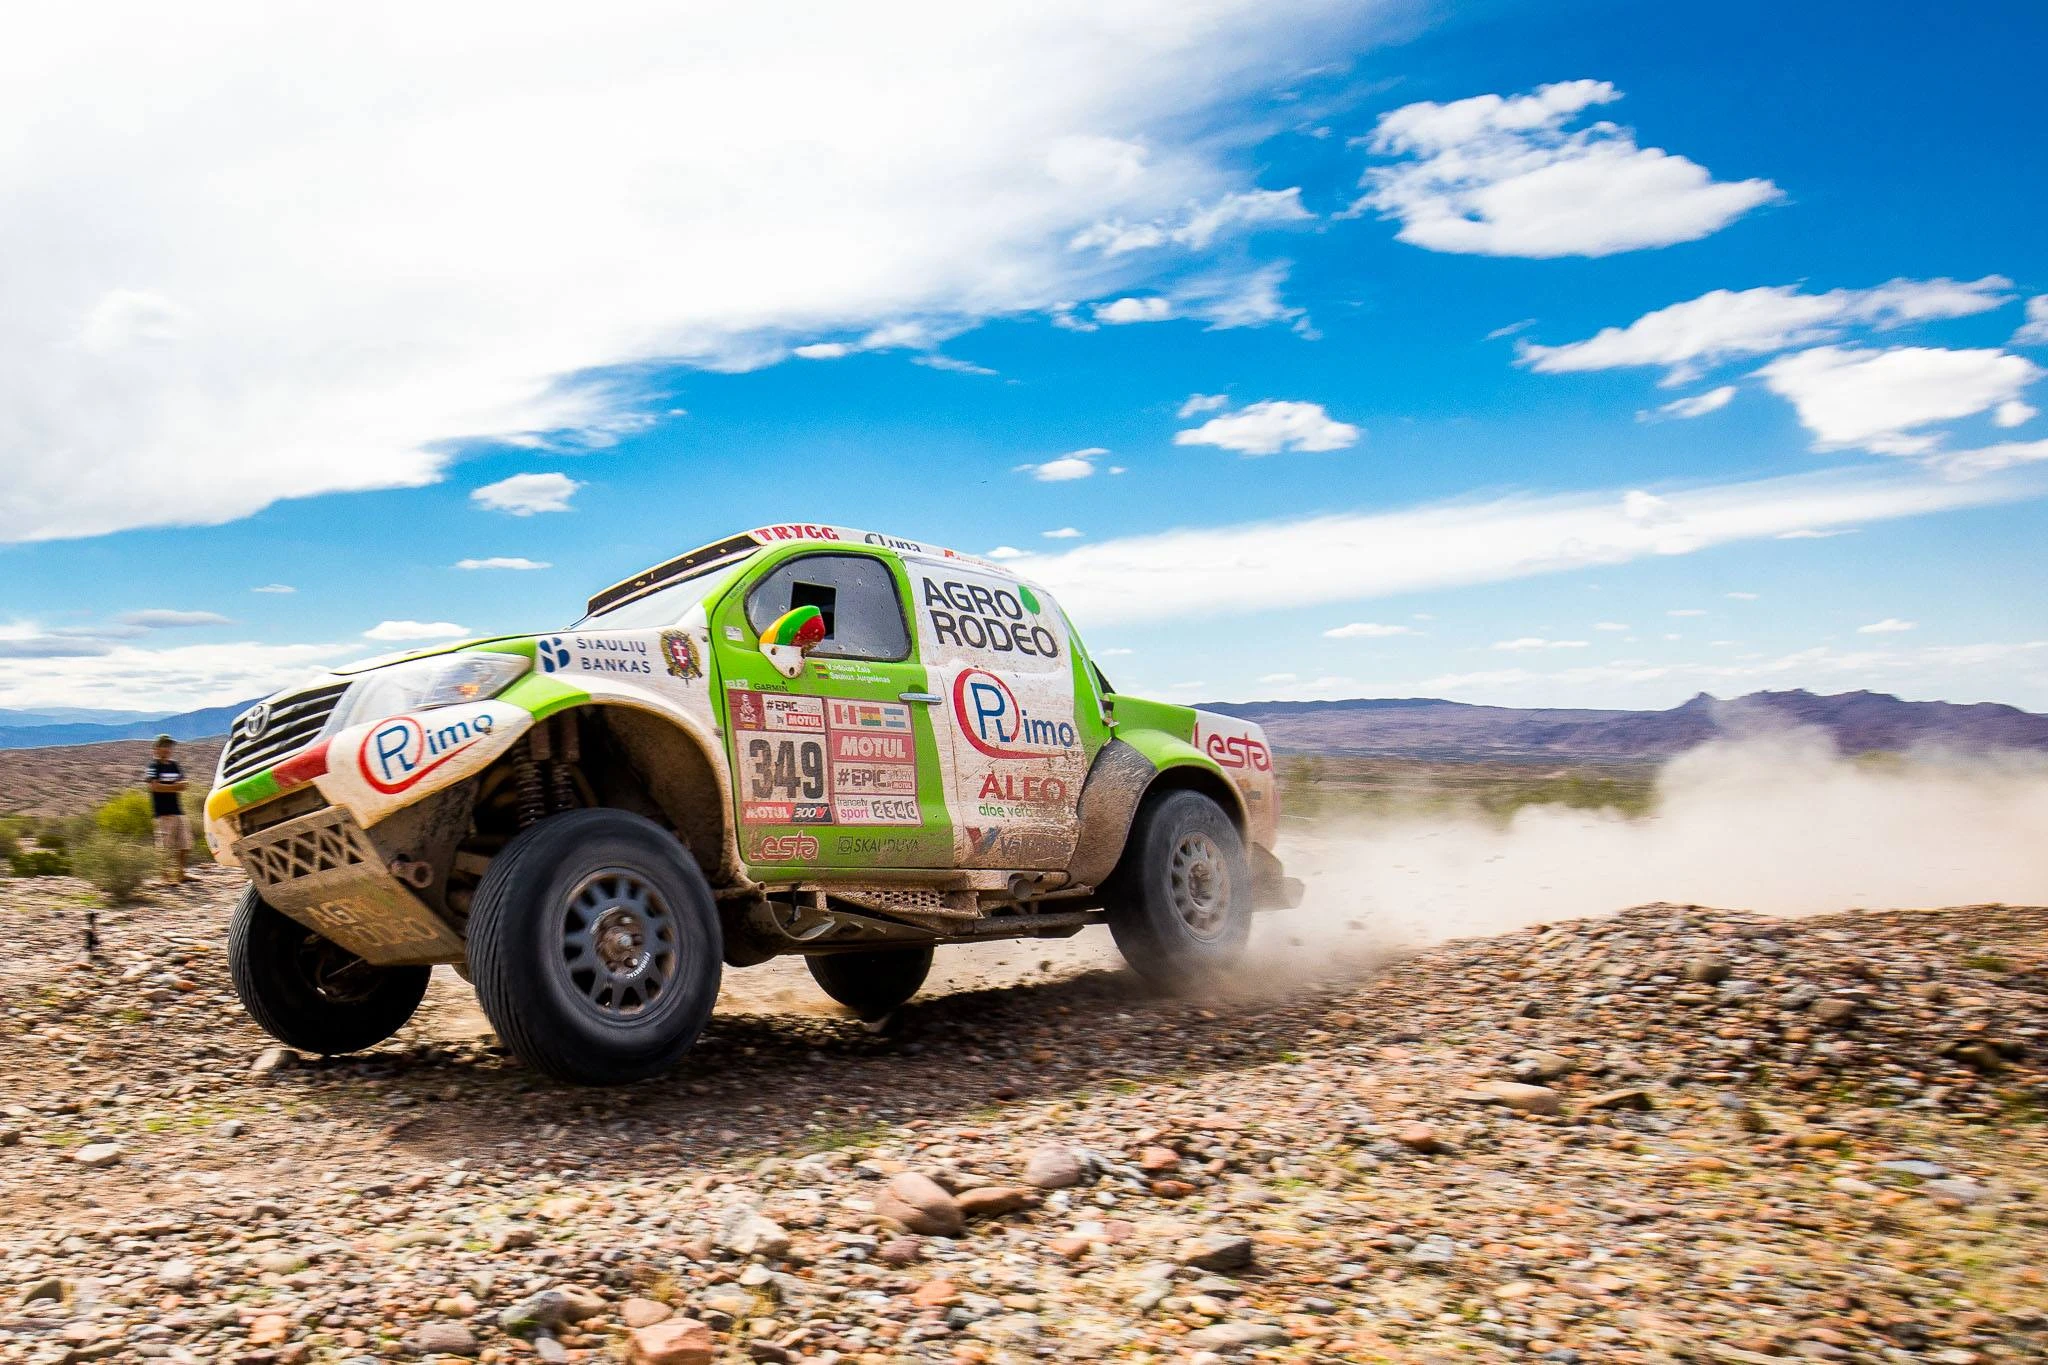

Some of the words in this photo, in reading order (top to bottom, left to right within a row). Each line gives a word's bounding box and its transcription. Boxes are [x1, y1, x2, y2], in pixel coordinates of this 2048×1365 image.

[754, 525, 840, 541] TRYGG
[922, 577, 1023, 620] AGRO
[929, 609, 1059, 658] RODEO
[581, 657, 652, 674] BANKAS
[753, 683, 789, 692] GARMIN
[787, 715, 821, 727] MOTUL
[839, 735, 907, 759] MOTUL
[749, 739, 824, 799] 349
[977, 773, 1067, 801] ALEO
[840, 806, 870, 820] sport
[978, 804, 1005, 817] aloe
